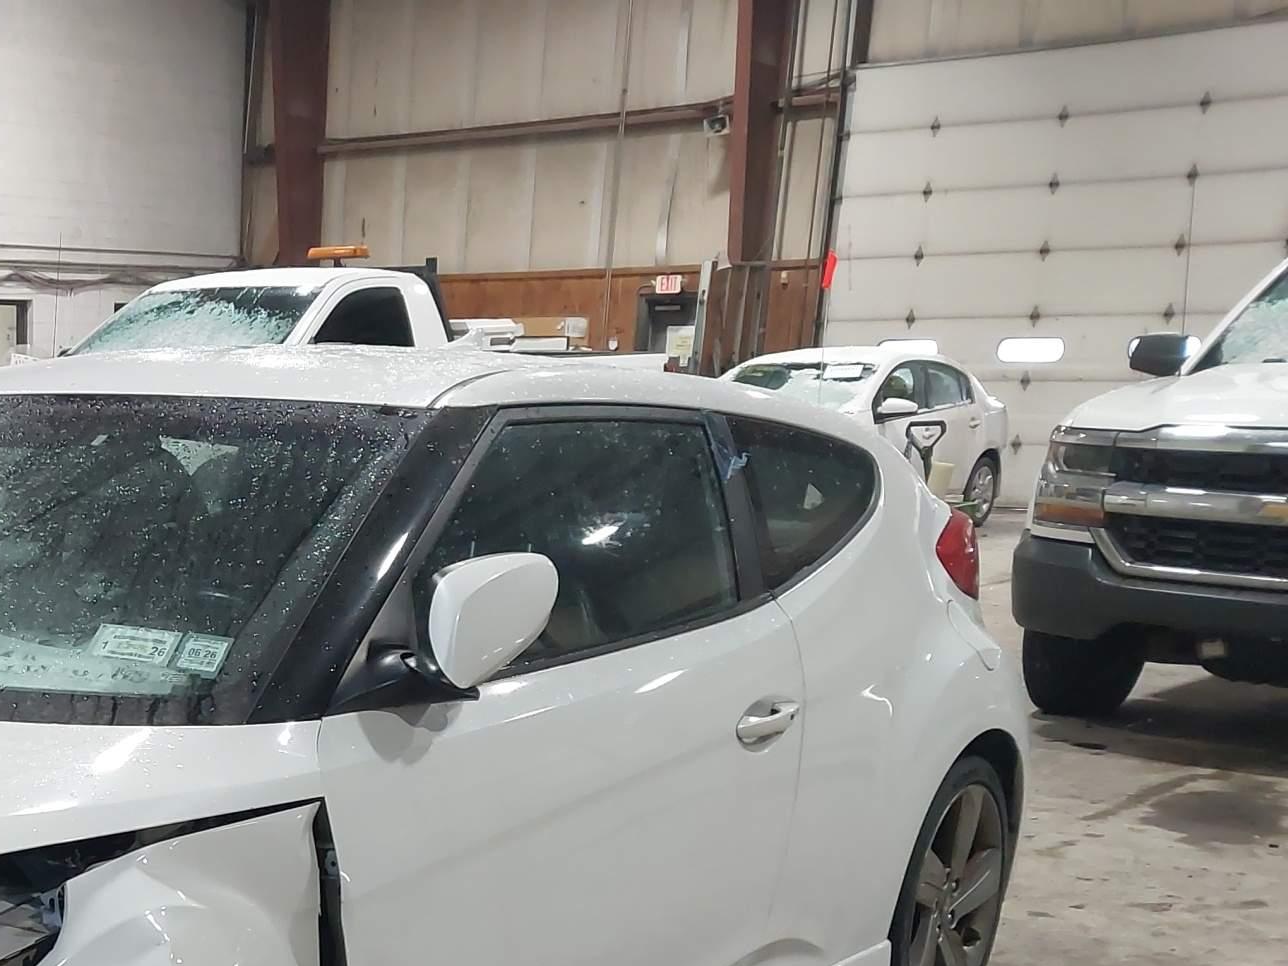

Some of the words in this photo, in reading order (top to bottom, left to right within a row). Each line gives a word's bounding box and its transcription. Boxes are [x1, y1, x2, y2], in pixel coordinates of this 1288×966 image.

[660, 276, 679, 291] EXIT
[149, 646, 168, 657] 26
[202, 649, 217, 659] 26
